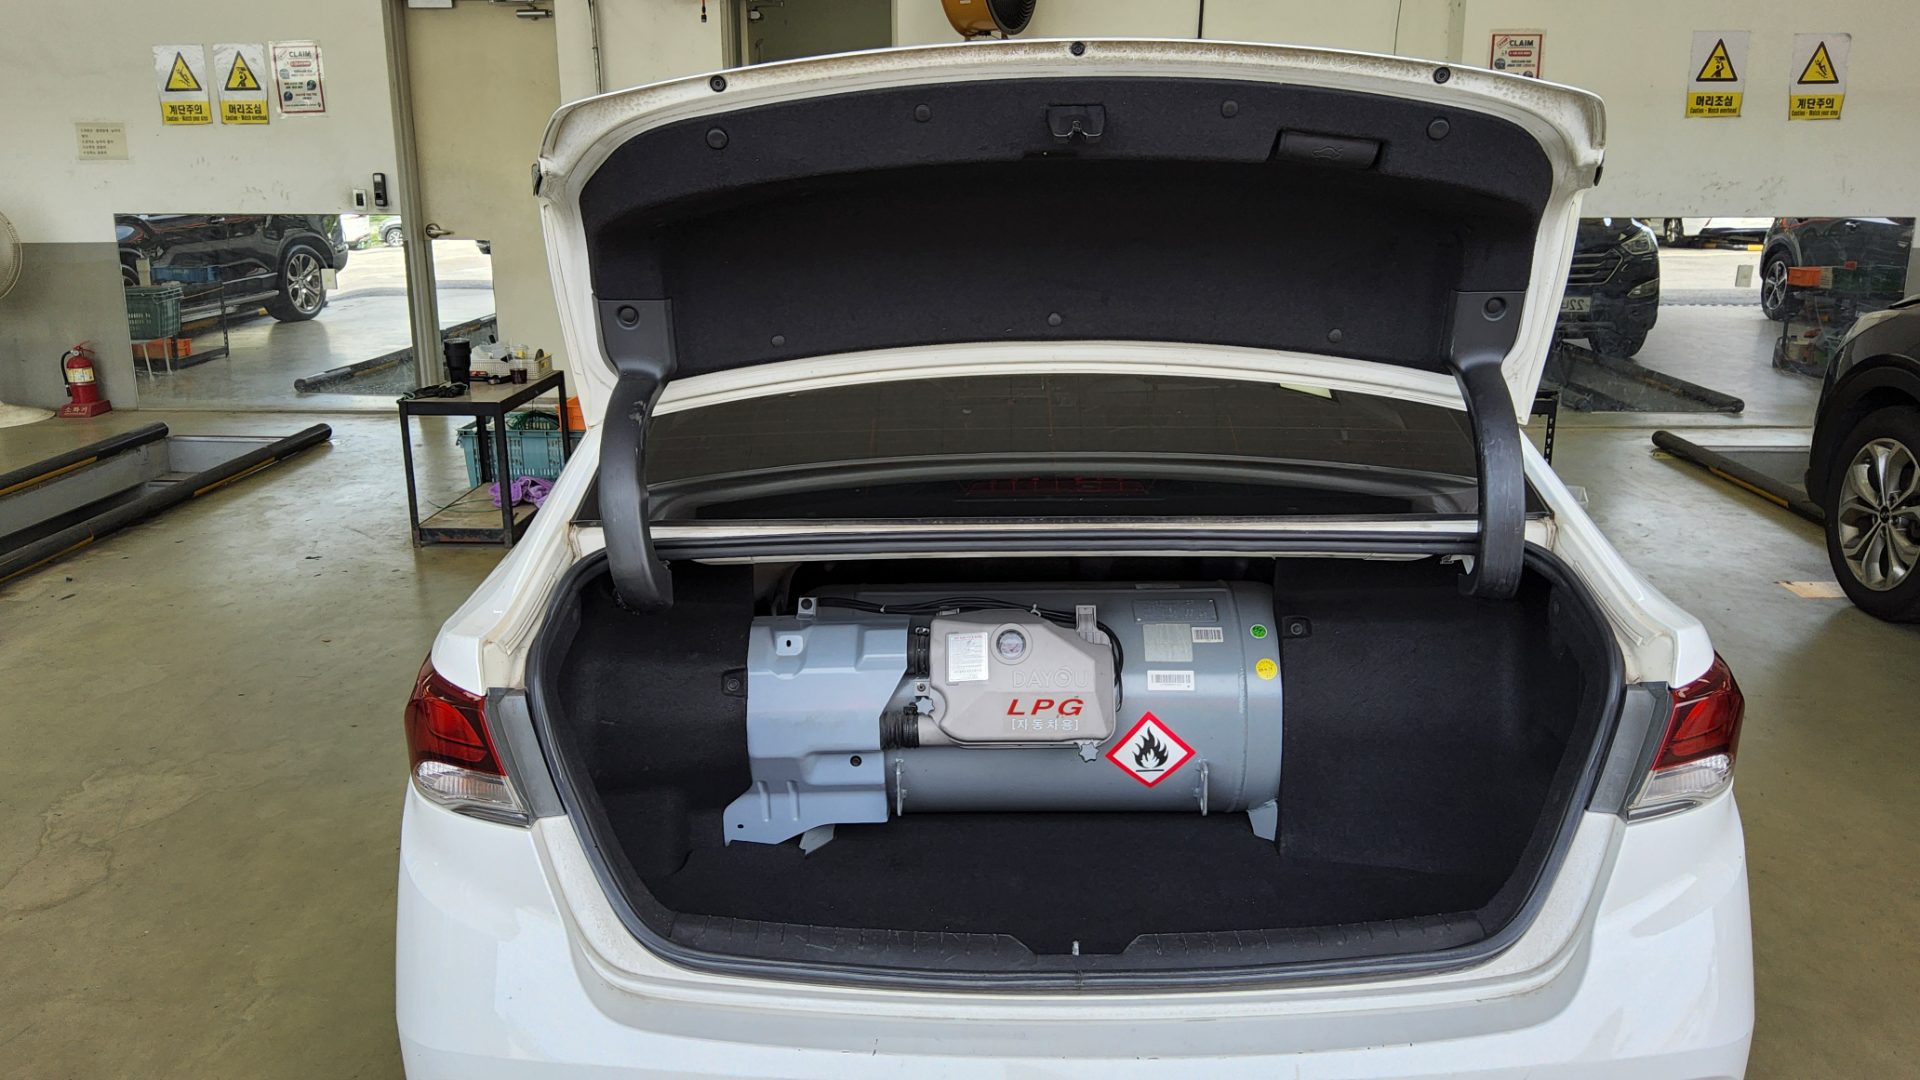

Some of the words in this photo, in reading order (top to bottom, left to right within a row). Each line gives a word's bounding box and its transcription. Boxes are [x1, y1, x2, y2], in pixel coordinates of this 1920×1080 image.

[1509, 39, 1534, 47] CLAIM
[289, 50, 312, 58] CLAIM
[1695, 95, 1733, 107] 머리조심
[1797, 98, 1834, 109] 계단주의
[169, 104, 203, 115] 계단주의
[228, 104, 262, 114] 머리조심
[1012, 665, 1089, 688] DAYOU
[1007, 698, 1085, 716] LPG
[1011, 718, 1079, 731] [자동차용]
